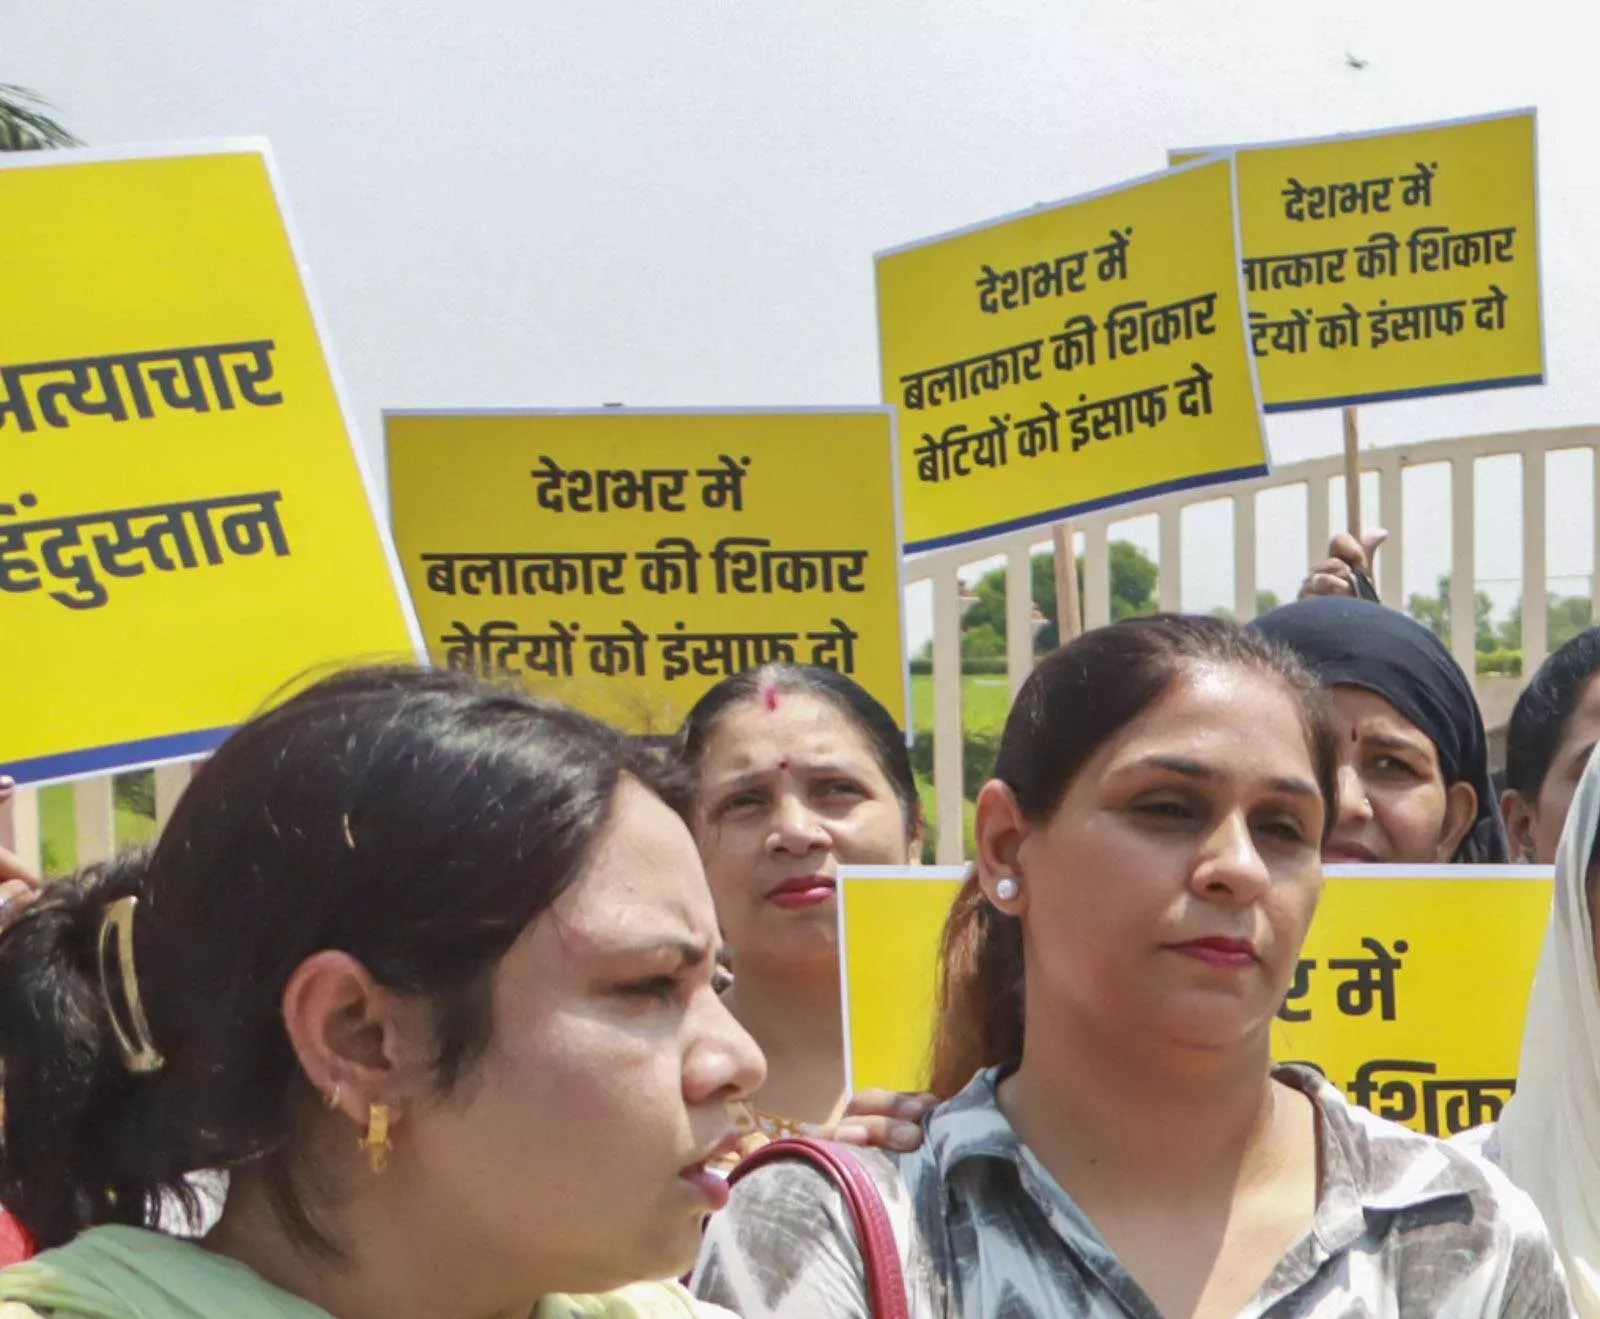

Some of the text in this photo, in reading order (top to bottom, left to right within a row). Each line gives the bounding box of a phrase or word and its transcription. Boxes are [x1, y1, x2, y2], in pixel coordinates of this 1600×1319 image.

[1281, 162, 1437, 221] देशभर में
[976, 227, 1132, 313] देशभर में
[1354, 232, 1400, 278] की
[1406, 227, 1516, 273] शिकार
[1316, 303, 1361, 349] को
[1367, 300, 1466, 348] इंसाफ
[1472, 285, 1507, 330] दो
[900, 293, 1217, 410] बलात्कार की शिकार
[914, 363, 1213, 482] बेटियों को इंसाफ दो
[531, 455, 750, 512] देशभर में
[421, 537, 868, 595] बलात्कार की शिकार
[584, 620, 649, 676] को
[1329, 938, 1408, 1020] में
